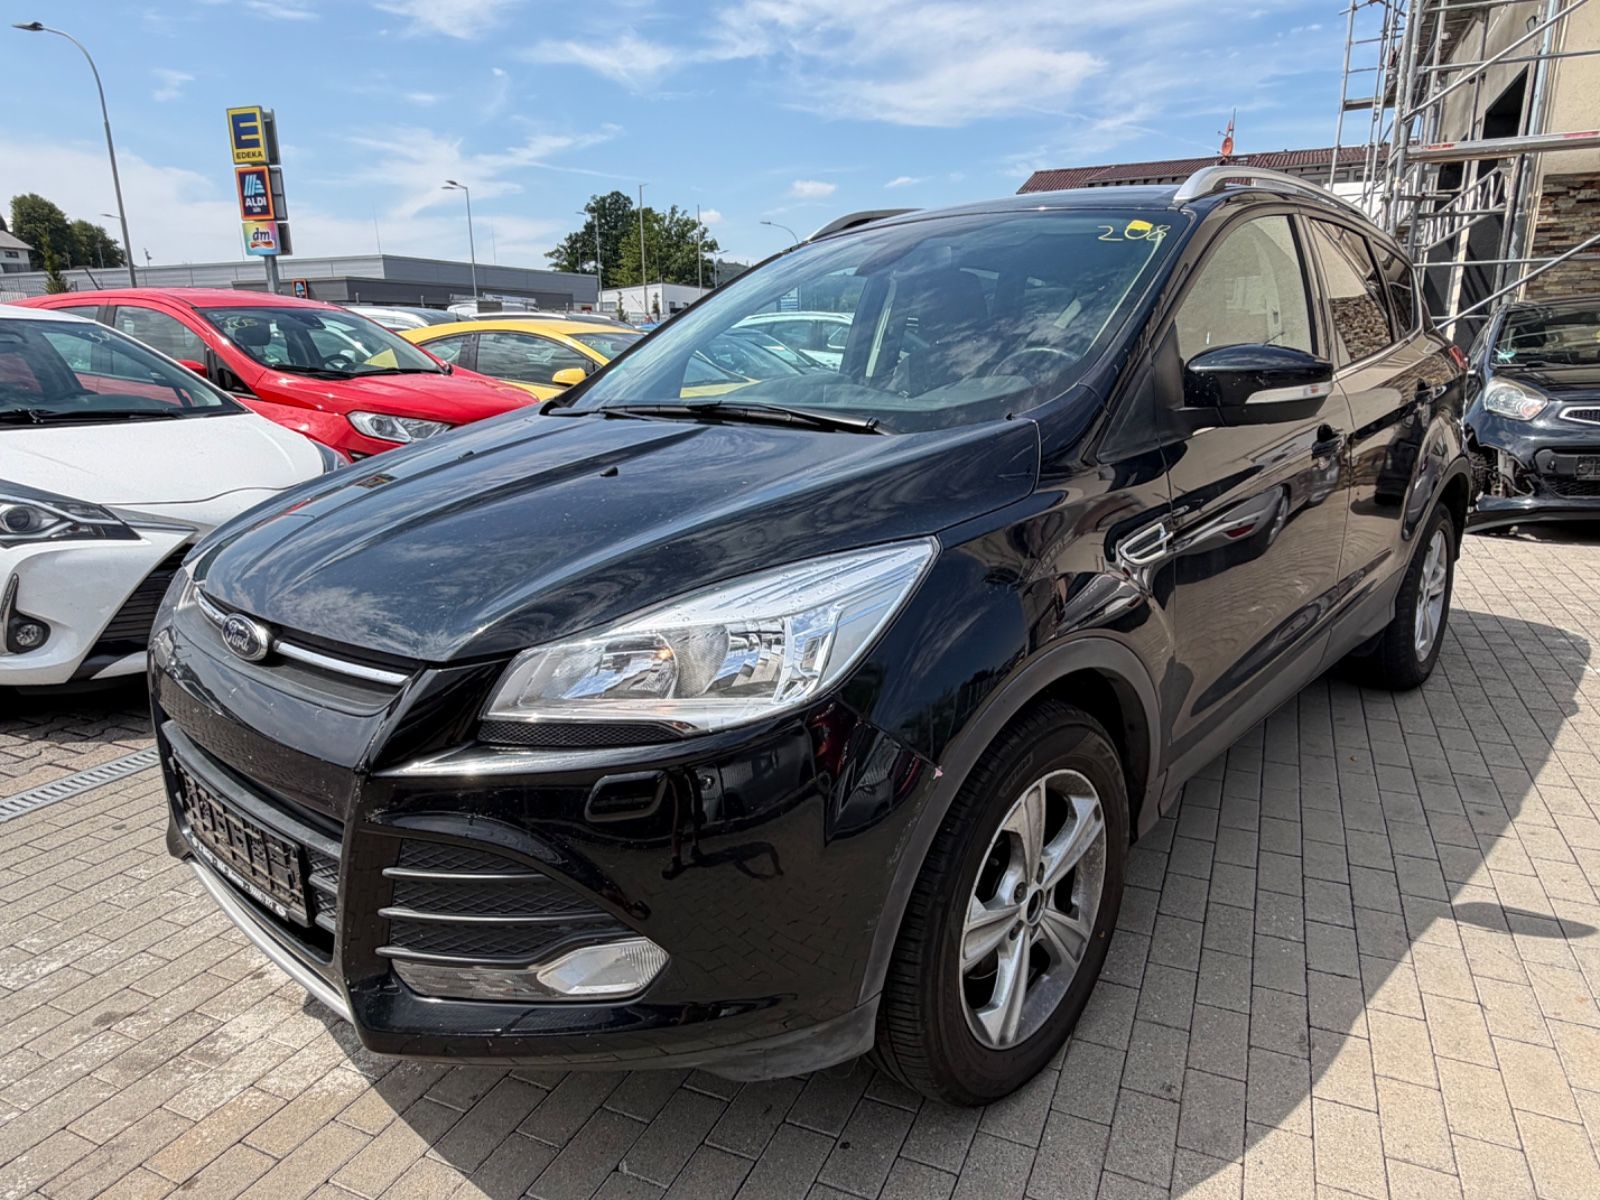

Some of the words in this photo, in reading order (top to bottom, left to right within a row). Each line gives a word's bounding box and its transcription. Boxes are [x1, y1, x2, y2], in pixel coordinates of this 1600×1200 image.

[231, 112, 261, 150] E
[236, 151, 263, 160] EDEKA
[245, 196, 267, 207] ALDI
[252, 227, 270, 241] dm
[226, 620, 250, 651] Ford
